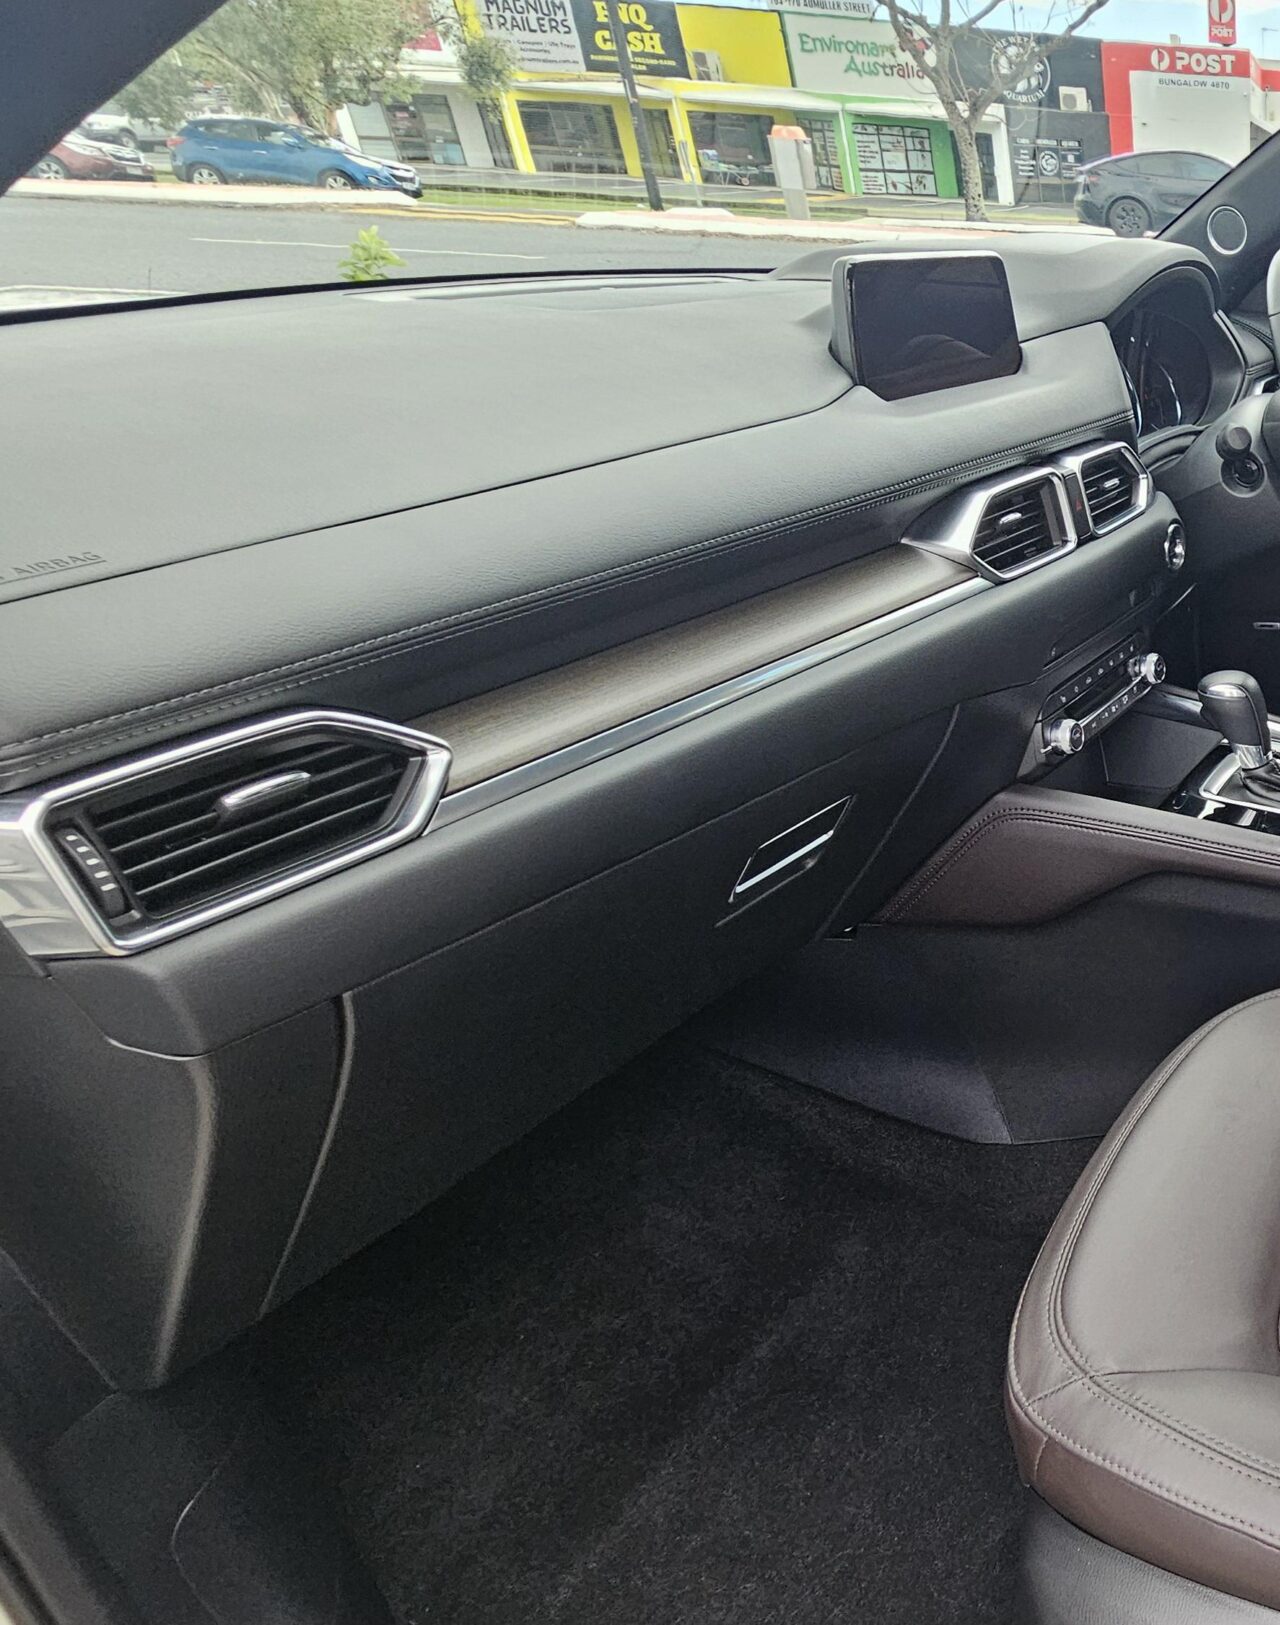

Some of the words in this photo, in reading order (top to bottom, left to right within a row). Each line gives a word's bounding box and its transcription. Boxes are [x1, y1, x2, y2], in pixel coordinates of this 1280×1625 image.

[484, 0, 567, 17] MAGNUM
[844, 2, 871, 13] STREET
[482, 13, 572, 34] TRAILERS
[1211, 27, 1234, 38] POST
[594, 30, 666, 54] CSH
[1175, 50, 1236, 74] POST
[1158, 77, 1208, 89] BUNGALOW
[1210, 80, 1230, 90] 4870
[11, 551, 102, 574] AIRBAG
